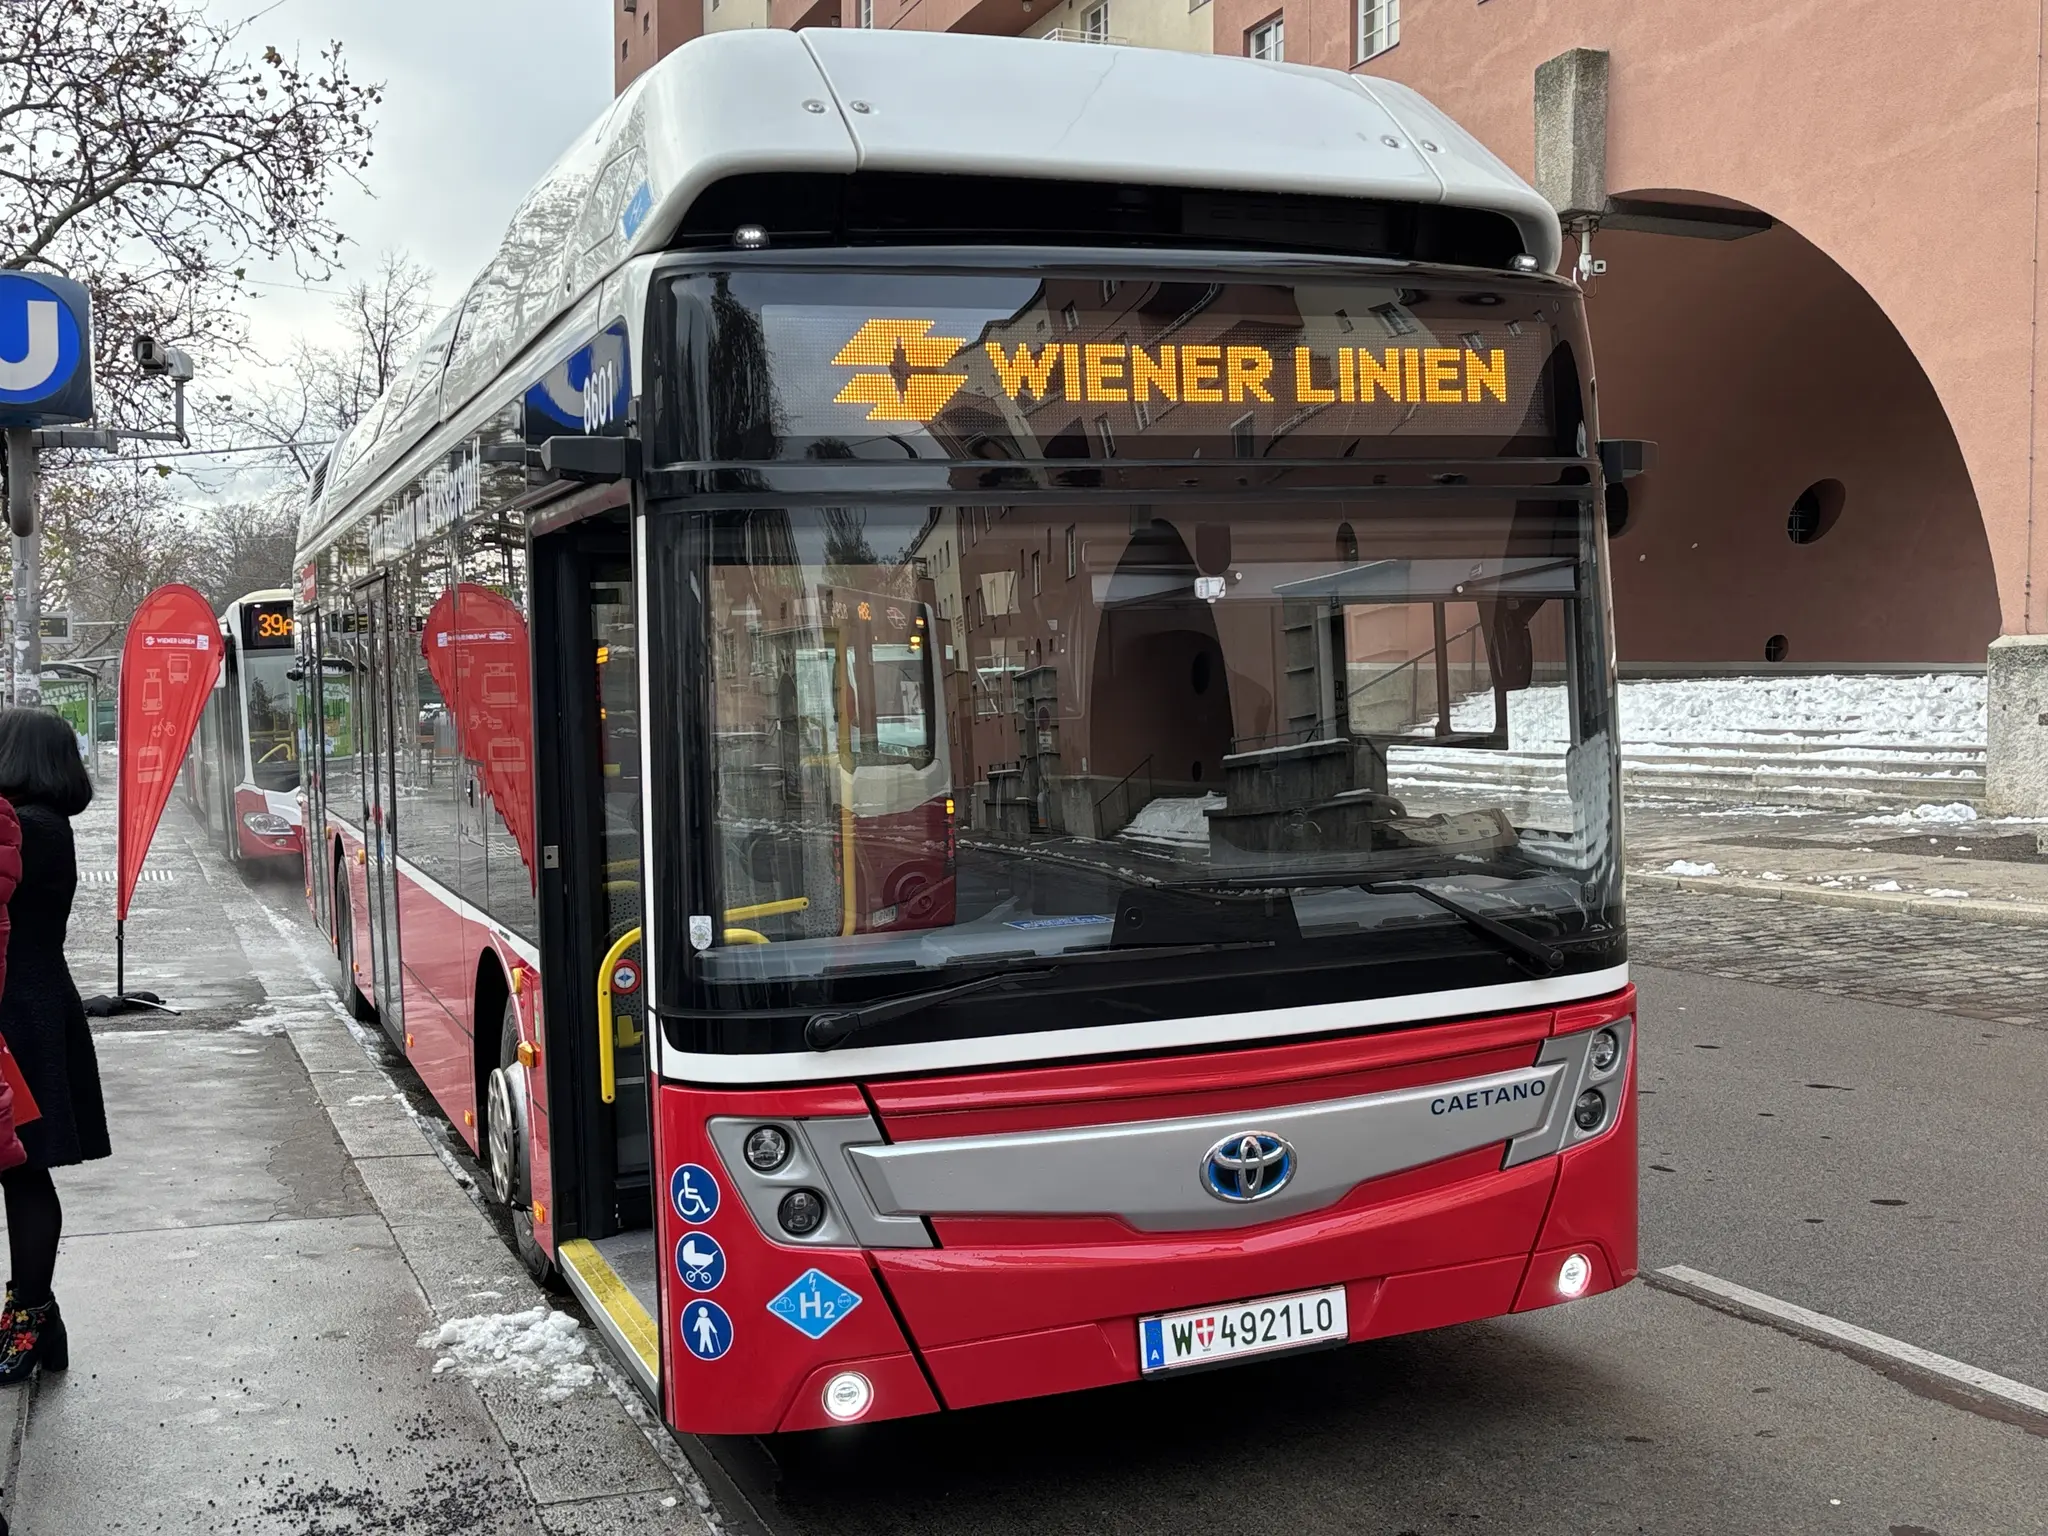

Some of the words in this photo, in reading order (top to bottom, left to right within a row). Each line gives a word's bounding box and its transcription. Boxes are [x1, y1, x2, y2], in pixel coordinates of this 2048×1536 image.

[984, 341, 1275, 403] WIENER
[1294, 346, 1507, 403] LINIEN
[583, 360, 614, 435] 8601
[428, 436, 480, 535] Wasserstoff
[258, 613, 296, 637] 39A
[1431, 1080, 1546, 1115] CAETANO
[800, 1291, 835, 1319] H2
[1150, 1349, 1160, 1361] A
[1171, 1320, 1193, 1357] W
